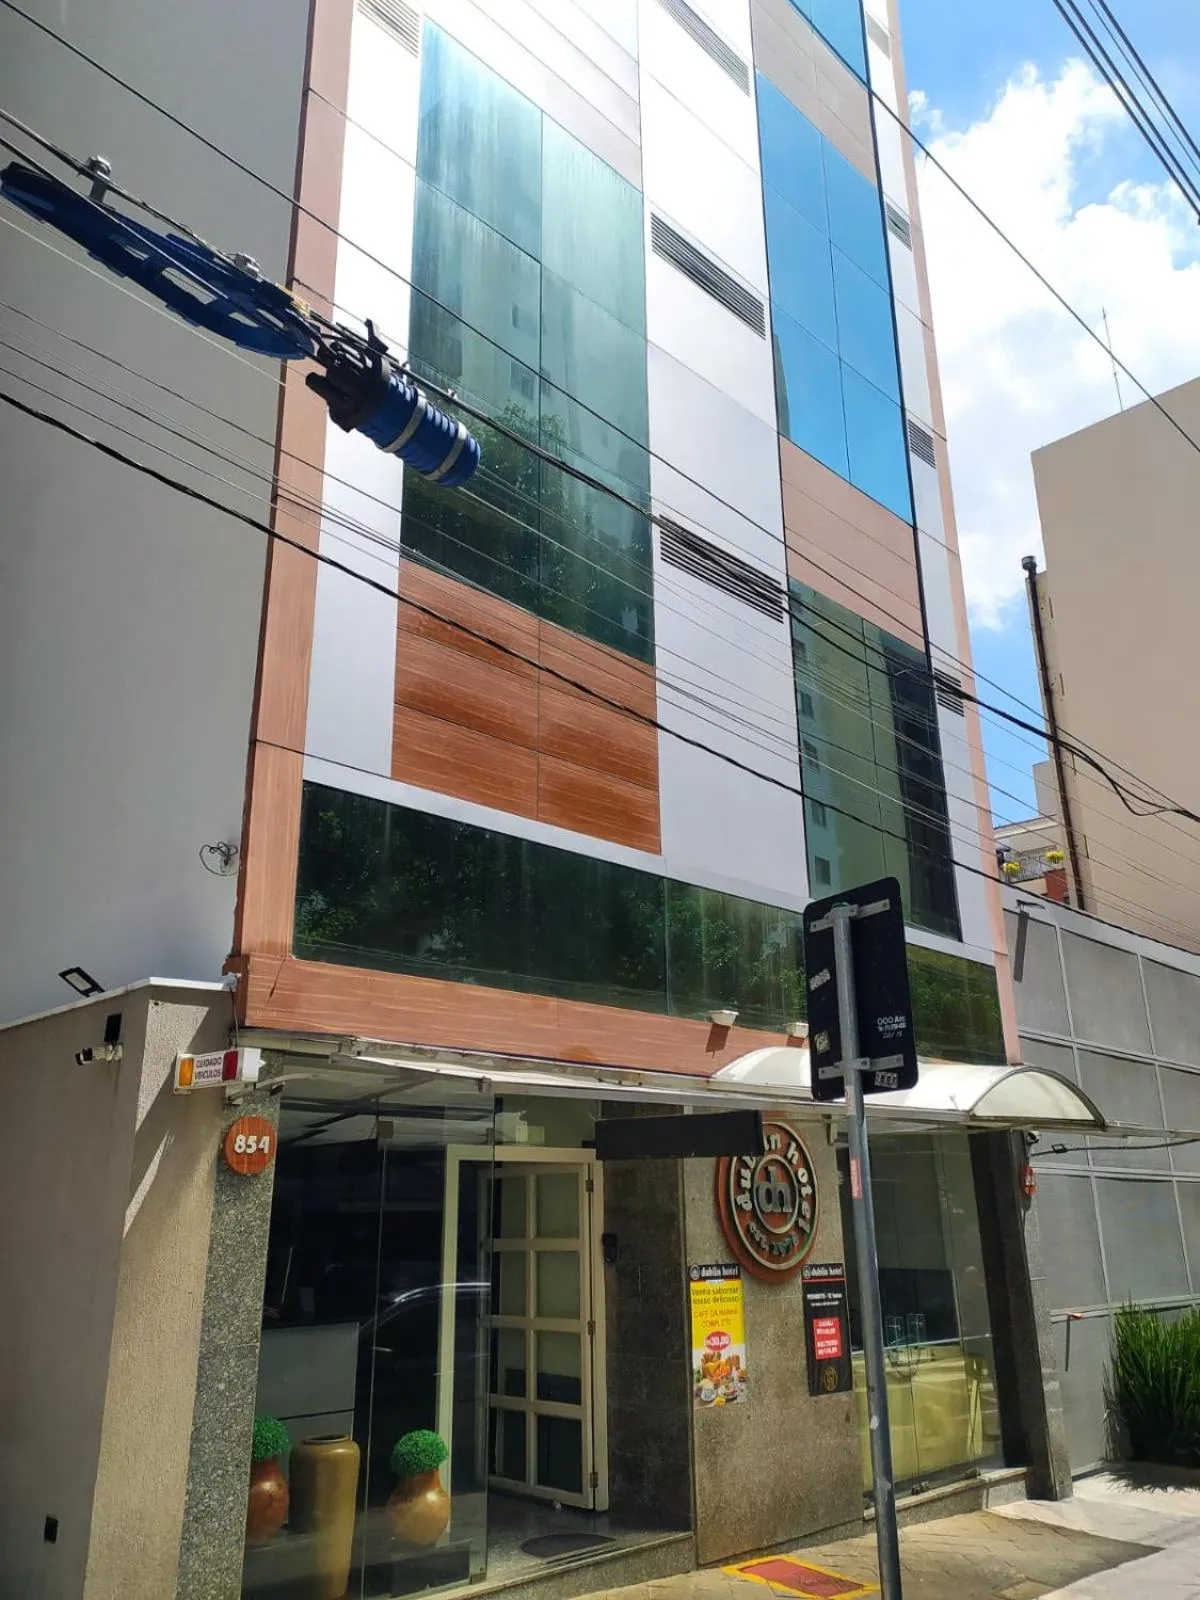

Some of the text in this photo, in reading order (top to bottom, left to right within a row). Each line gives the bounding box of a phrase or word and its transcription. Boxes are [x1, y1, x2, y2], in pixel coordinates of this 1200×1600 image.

[196, 1056, 222, 1068] CUIDADO
[234, 1134, 270, 1154] 854
[786, 1140, 813, 1234] hotel
[712, 1286, 740, 1296] saborear
